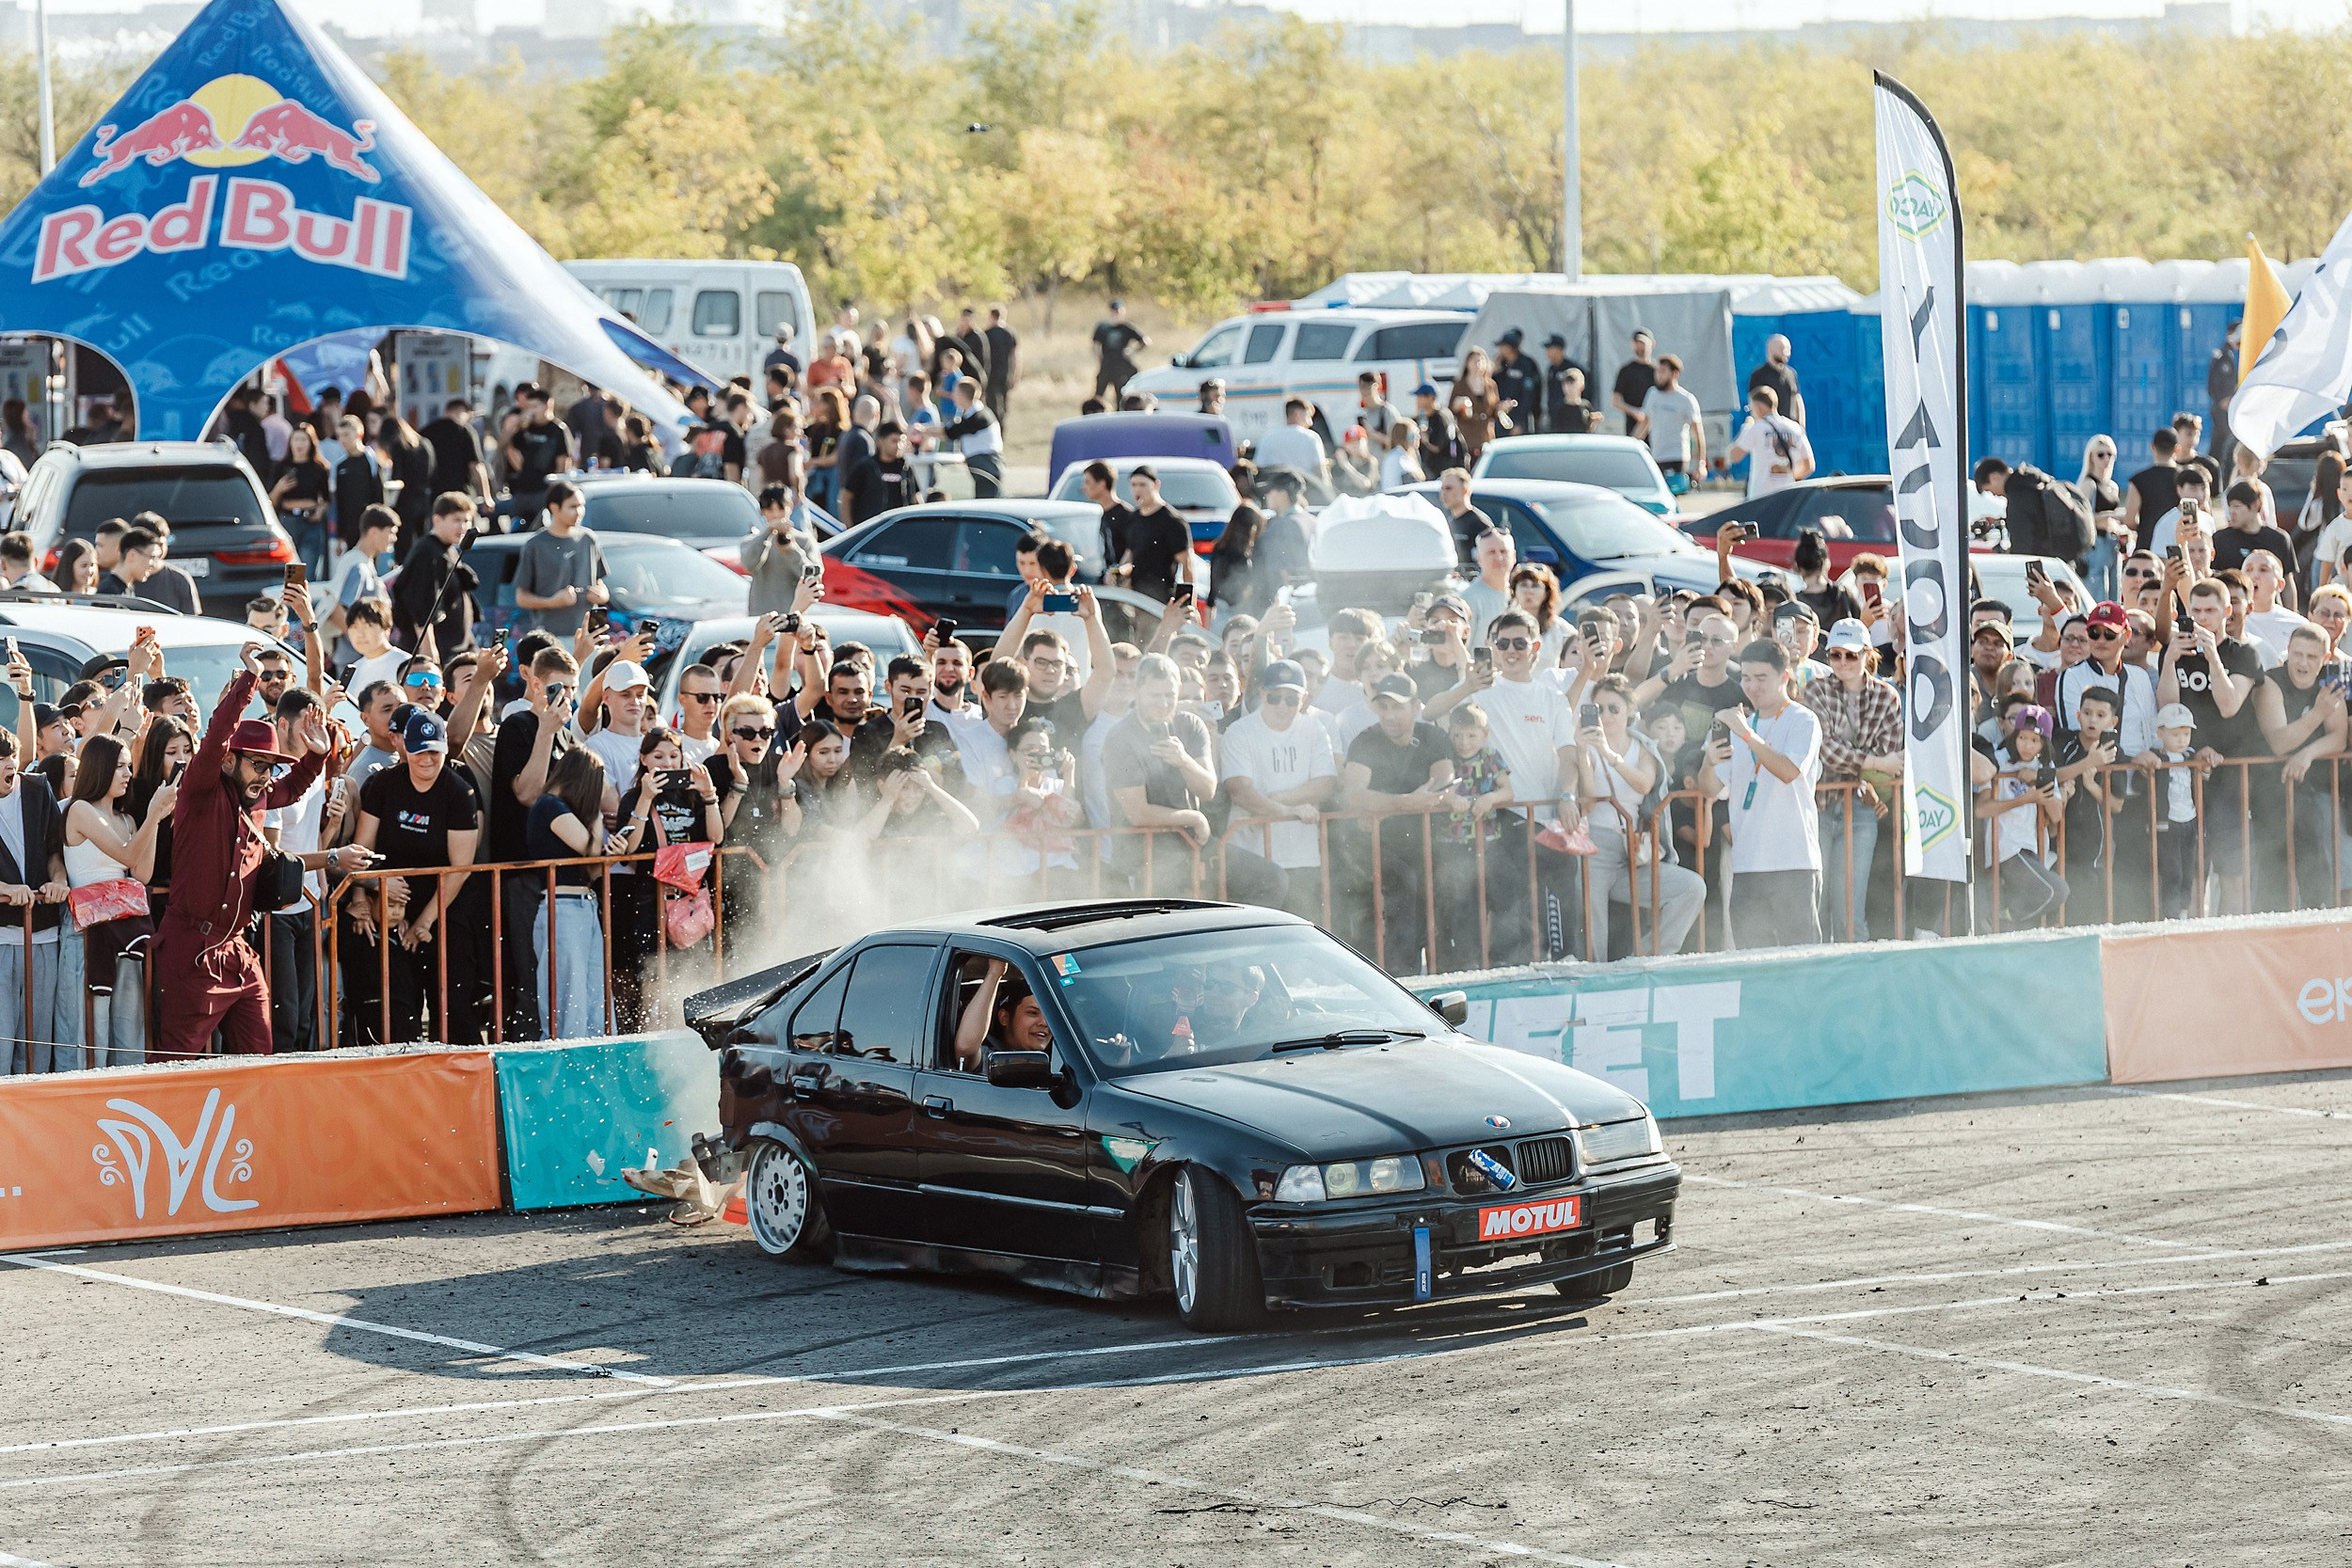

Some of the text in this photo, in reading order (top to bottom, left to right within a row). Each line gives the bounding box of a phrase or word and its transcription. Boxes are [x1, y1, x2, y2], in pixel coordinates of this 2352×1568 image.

[32, 174, 218, 284] Red
[218, 177, 412, 280] Bull
[1484, 1200, 1577, 1236] MOTUL
